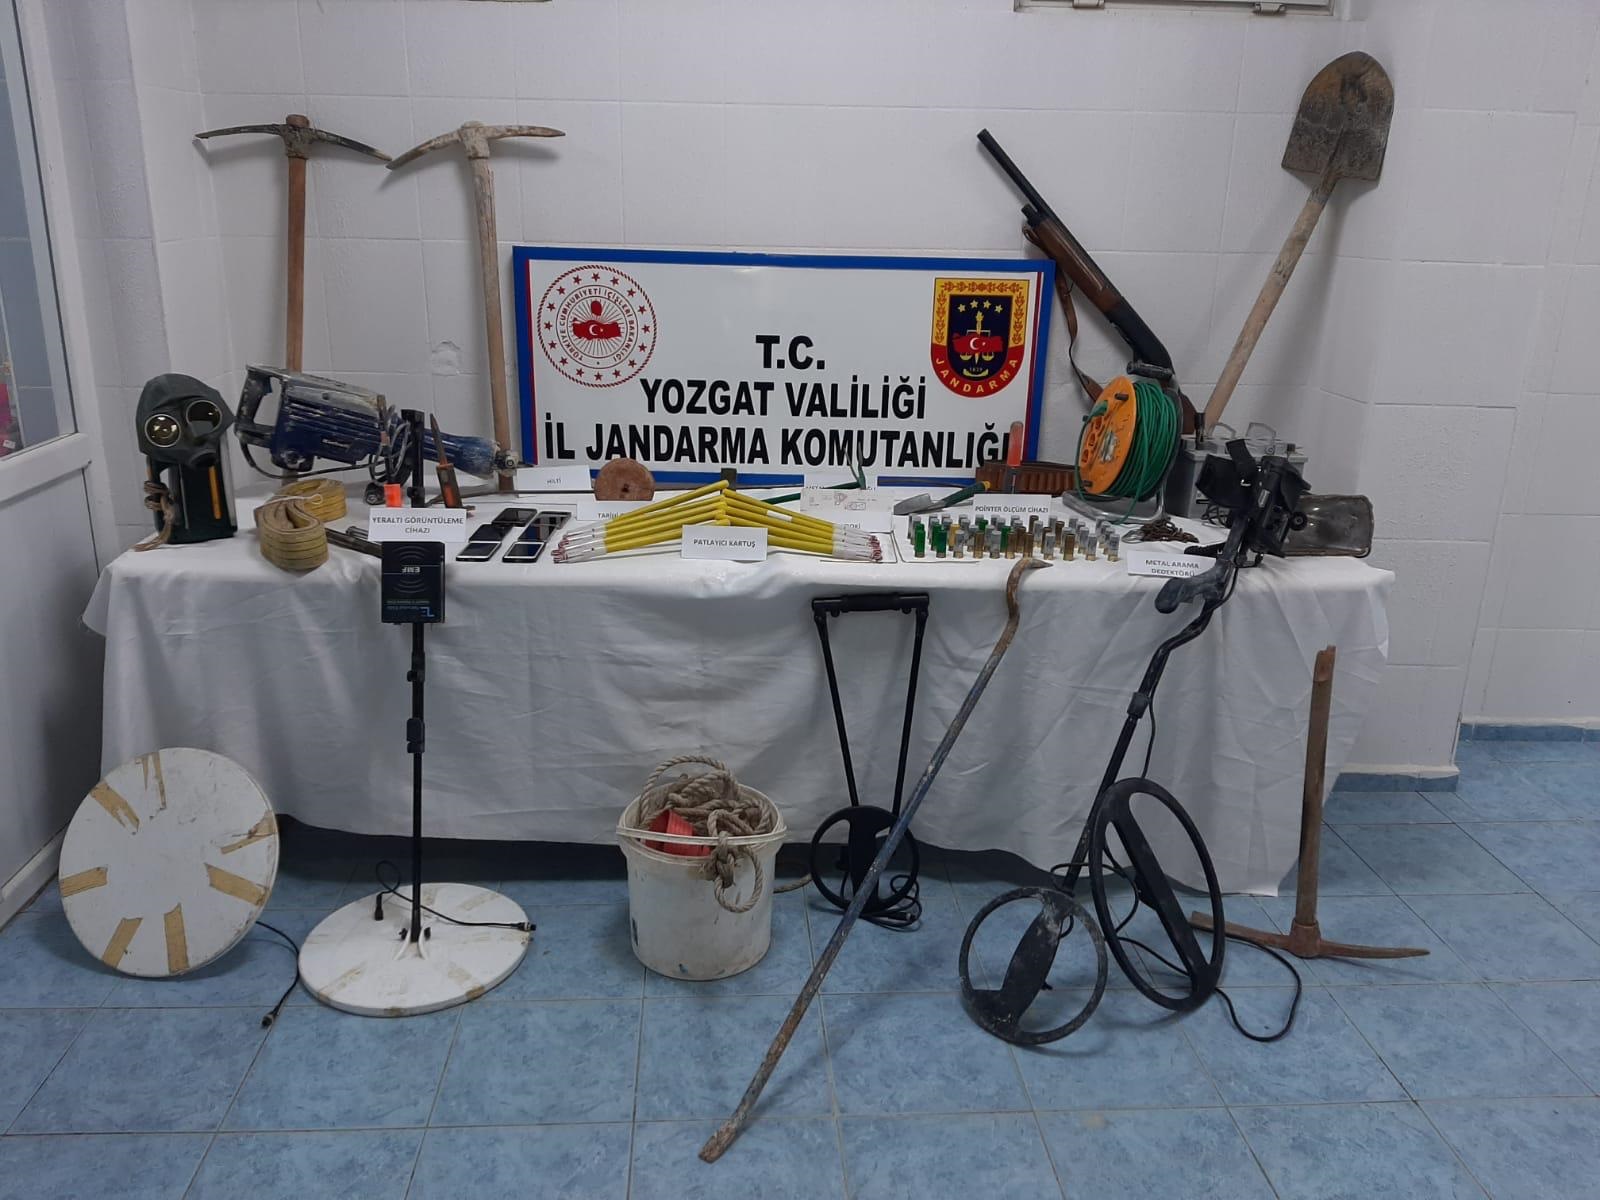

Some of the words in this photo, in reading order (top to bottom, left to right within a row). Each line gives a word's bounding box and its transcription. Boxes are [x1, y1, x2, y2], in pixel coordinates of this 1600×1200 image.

[560, 287, 602, 326] CUMHURİYETİ
[755, 335, 825, 369] T.C.
[936, 358, 1018, 393] JANDARMA
[640, 378, 774, 416] YOZGAT
[785, 375, 926, 419] VALİLİĞİ
[545, 412, 575, 459] İL
[586, 423, 770, 464] JANDARMA
[781, 422, 1010, 468] KOMUTANLIĞI
[372, 516, 402, 524] YERALTI
[404, 516, 464, 524] GÖRÜNTÜLEME
[405, 526, 431, 534] CİHAZI
[693, 538, 727, 547] PATLAYICI
[729, 540, 756, 548] KARTUŞ
[1145, 559, 1170, 567] METAL
[1171, 561, 1199, 569] ARAMA
